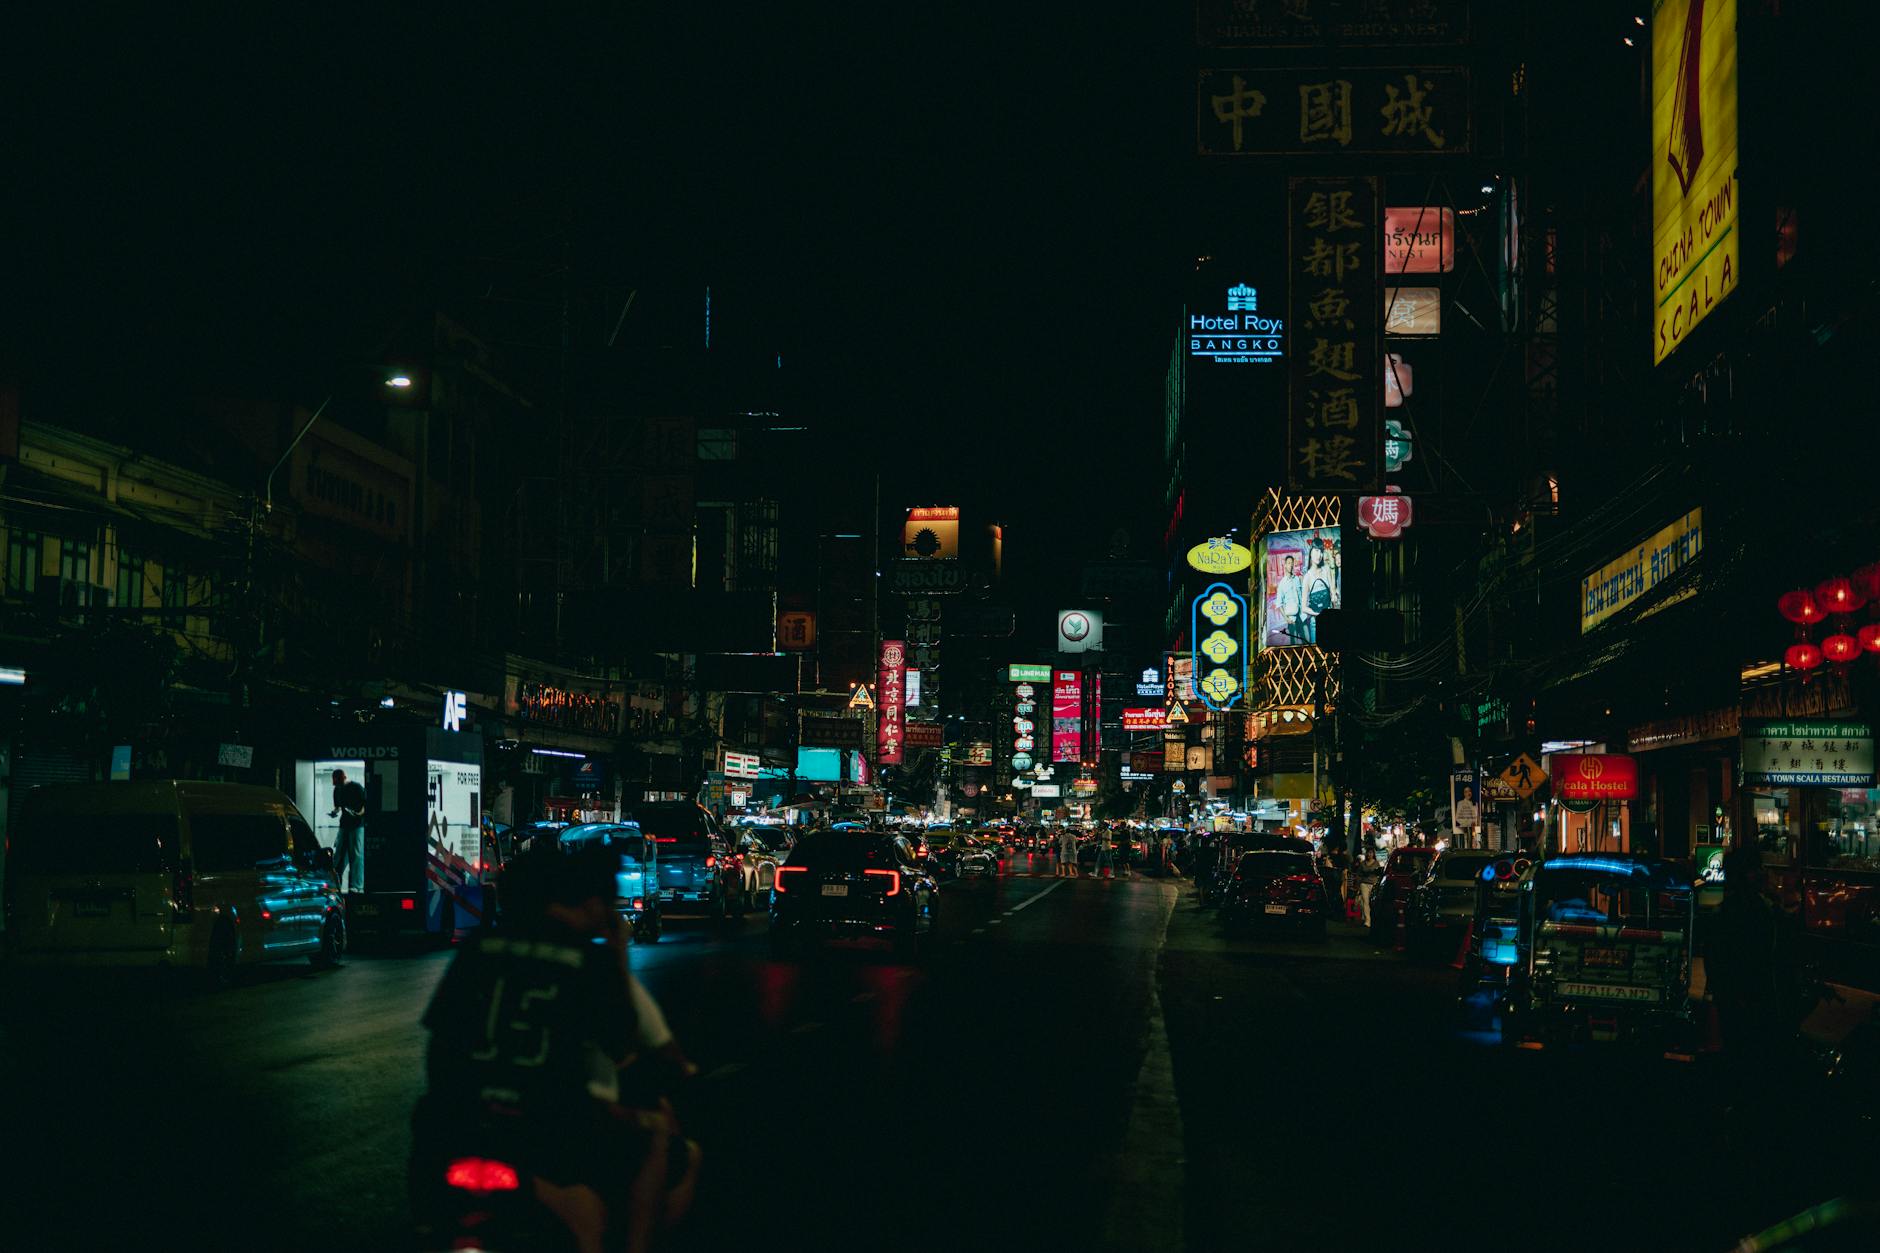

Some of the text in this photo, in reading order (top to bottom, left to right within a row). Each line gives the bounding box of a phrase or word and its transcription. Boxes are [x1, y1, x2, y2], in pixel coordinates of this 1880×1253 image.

[1210, 71, 1446, 151] 中國城
[1659, 175, 1732, 291] CHINA TOWN
[1659, 253, 1732, 356] SCALA
[1191, 314, 1238, 330] Hotel
[1300, 190, 1366, 481] 銀都魚翅酒樓
[1371, 498, 1399, 525] 媽
[1197, 551, 1240, 565] NaRaYa
[884, 669, 900, 755] 北京同仁堂
[331, 746, 399, 758] WORLD'S
[1558, 780, 1628, 790] cala Hostel
[1772, 774, 1795, 783] TOWN
[1796, 774, 1820, 783] SCALA
[1822, 774, 1870, 783] RESTAURANT
[1567, 983, 1650, 1000] THAILAND
